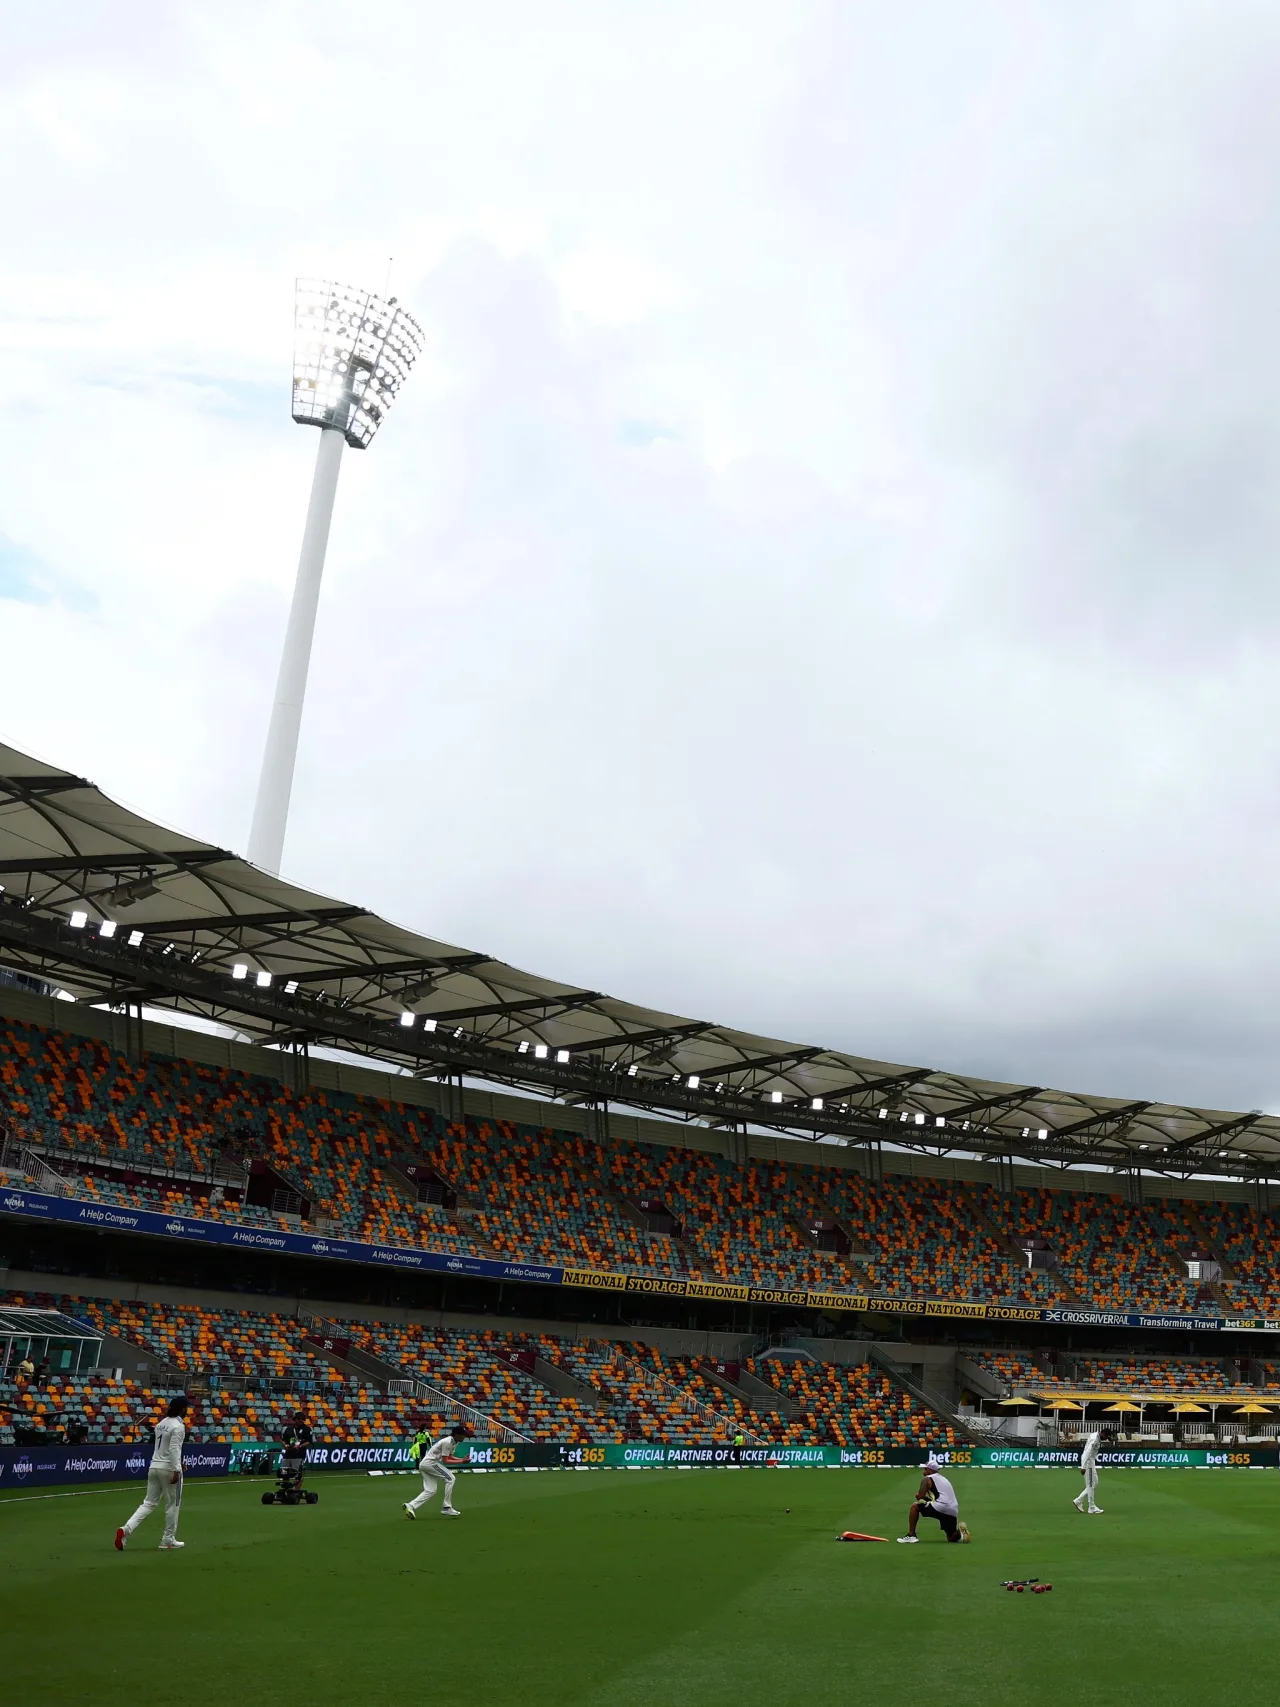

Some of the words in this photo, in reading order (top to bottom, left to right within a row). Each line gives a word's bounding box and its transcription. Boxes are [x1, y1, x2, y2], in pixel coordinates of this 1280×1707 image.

[4, 1198, 25, 1208] NRMA
[79, 1208, 86, 1217] A
[88, 1209, 104, 1221] Help
[105, 1211, 139, 1226] Company
[165, 1223, 184, 1233] NRMA
[233, 1232, 239, 1241] A
[240, 1233, 255, 1243] Help
[255, 1235, 286, 1247] Company
[372, 1250, 378, 1258] A
[379, 1251, 393, 1261] Help
[393, 1253, 422, 1264] Company
[504, 1267, 510, 1275] A
[511, 1267, 524, 1277] Help
[524, 1269, 551, 1280] Company
[562, 1271, 624, 1288] NATIONAL
[627, 1278, 685, 1295] STORAGE
[688, 1284, 746, 1299] NATIONAL
[751, 1290, 806, 1305] STORAGE
[808, 1295, 866, 1309] NATIONAL
[869, 1300, 924, 1313] STORAGE
[927, 1304, 984, 1317] NATIONAL
[987, 1308, 1041, 1320] STORAGE
[1139, 1316, 1192, 1329] Transforming
[1194, 1319, 1218, 1329] Travel
[1225, 1319, 1256, 1328] bet365
[158, 1434, 162, 1450] 1
[183, 1455, 197, 1467] Help
[197, 1454, 226, 1466] Company
[332, 1449, 347, 1462] OF
[349, 1449, 394, 1462] CRICKET
[470, 1447, 515, 1463] bet365
[624, 1449, 664, 1461] OFFICIAL
[668, 1450, 712, 1461] PARTNER
[714, 1451, 728, 1461] OF
[769, 1450, 823, 1461] AUSTRALIA
[841, 1450, 884, 1463] bet365
[929, 1450, 971, 1463] bet365
[991, 1452, 1034, 1462] OFFICIAL
[1038, 1452, 1078, 1462] PARTNER
[1096, 1453, 1136, 1463] CRICKET
[1137, 1453, 1189, 1463] AUSTRALIA
[1206, 1453, 1250, 1464] bet365
[12, 1463, 32, 1473] NRMA
[65, 1459, 71, 1471] A
[71, 1458, 86, 1472] Help
[87, 1458, 118, 1471] Company
[126, 1458, 145, 1468] NRMA
